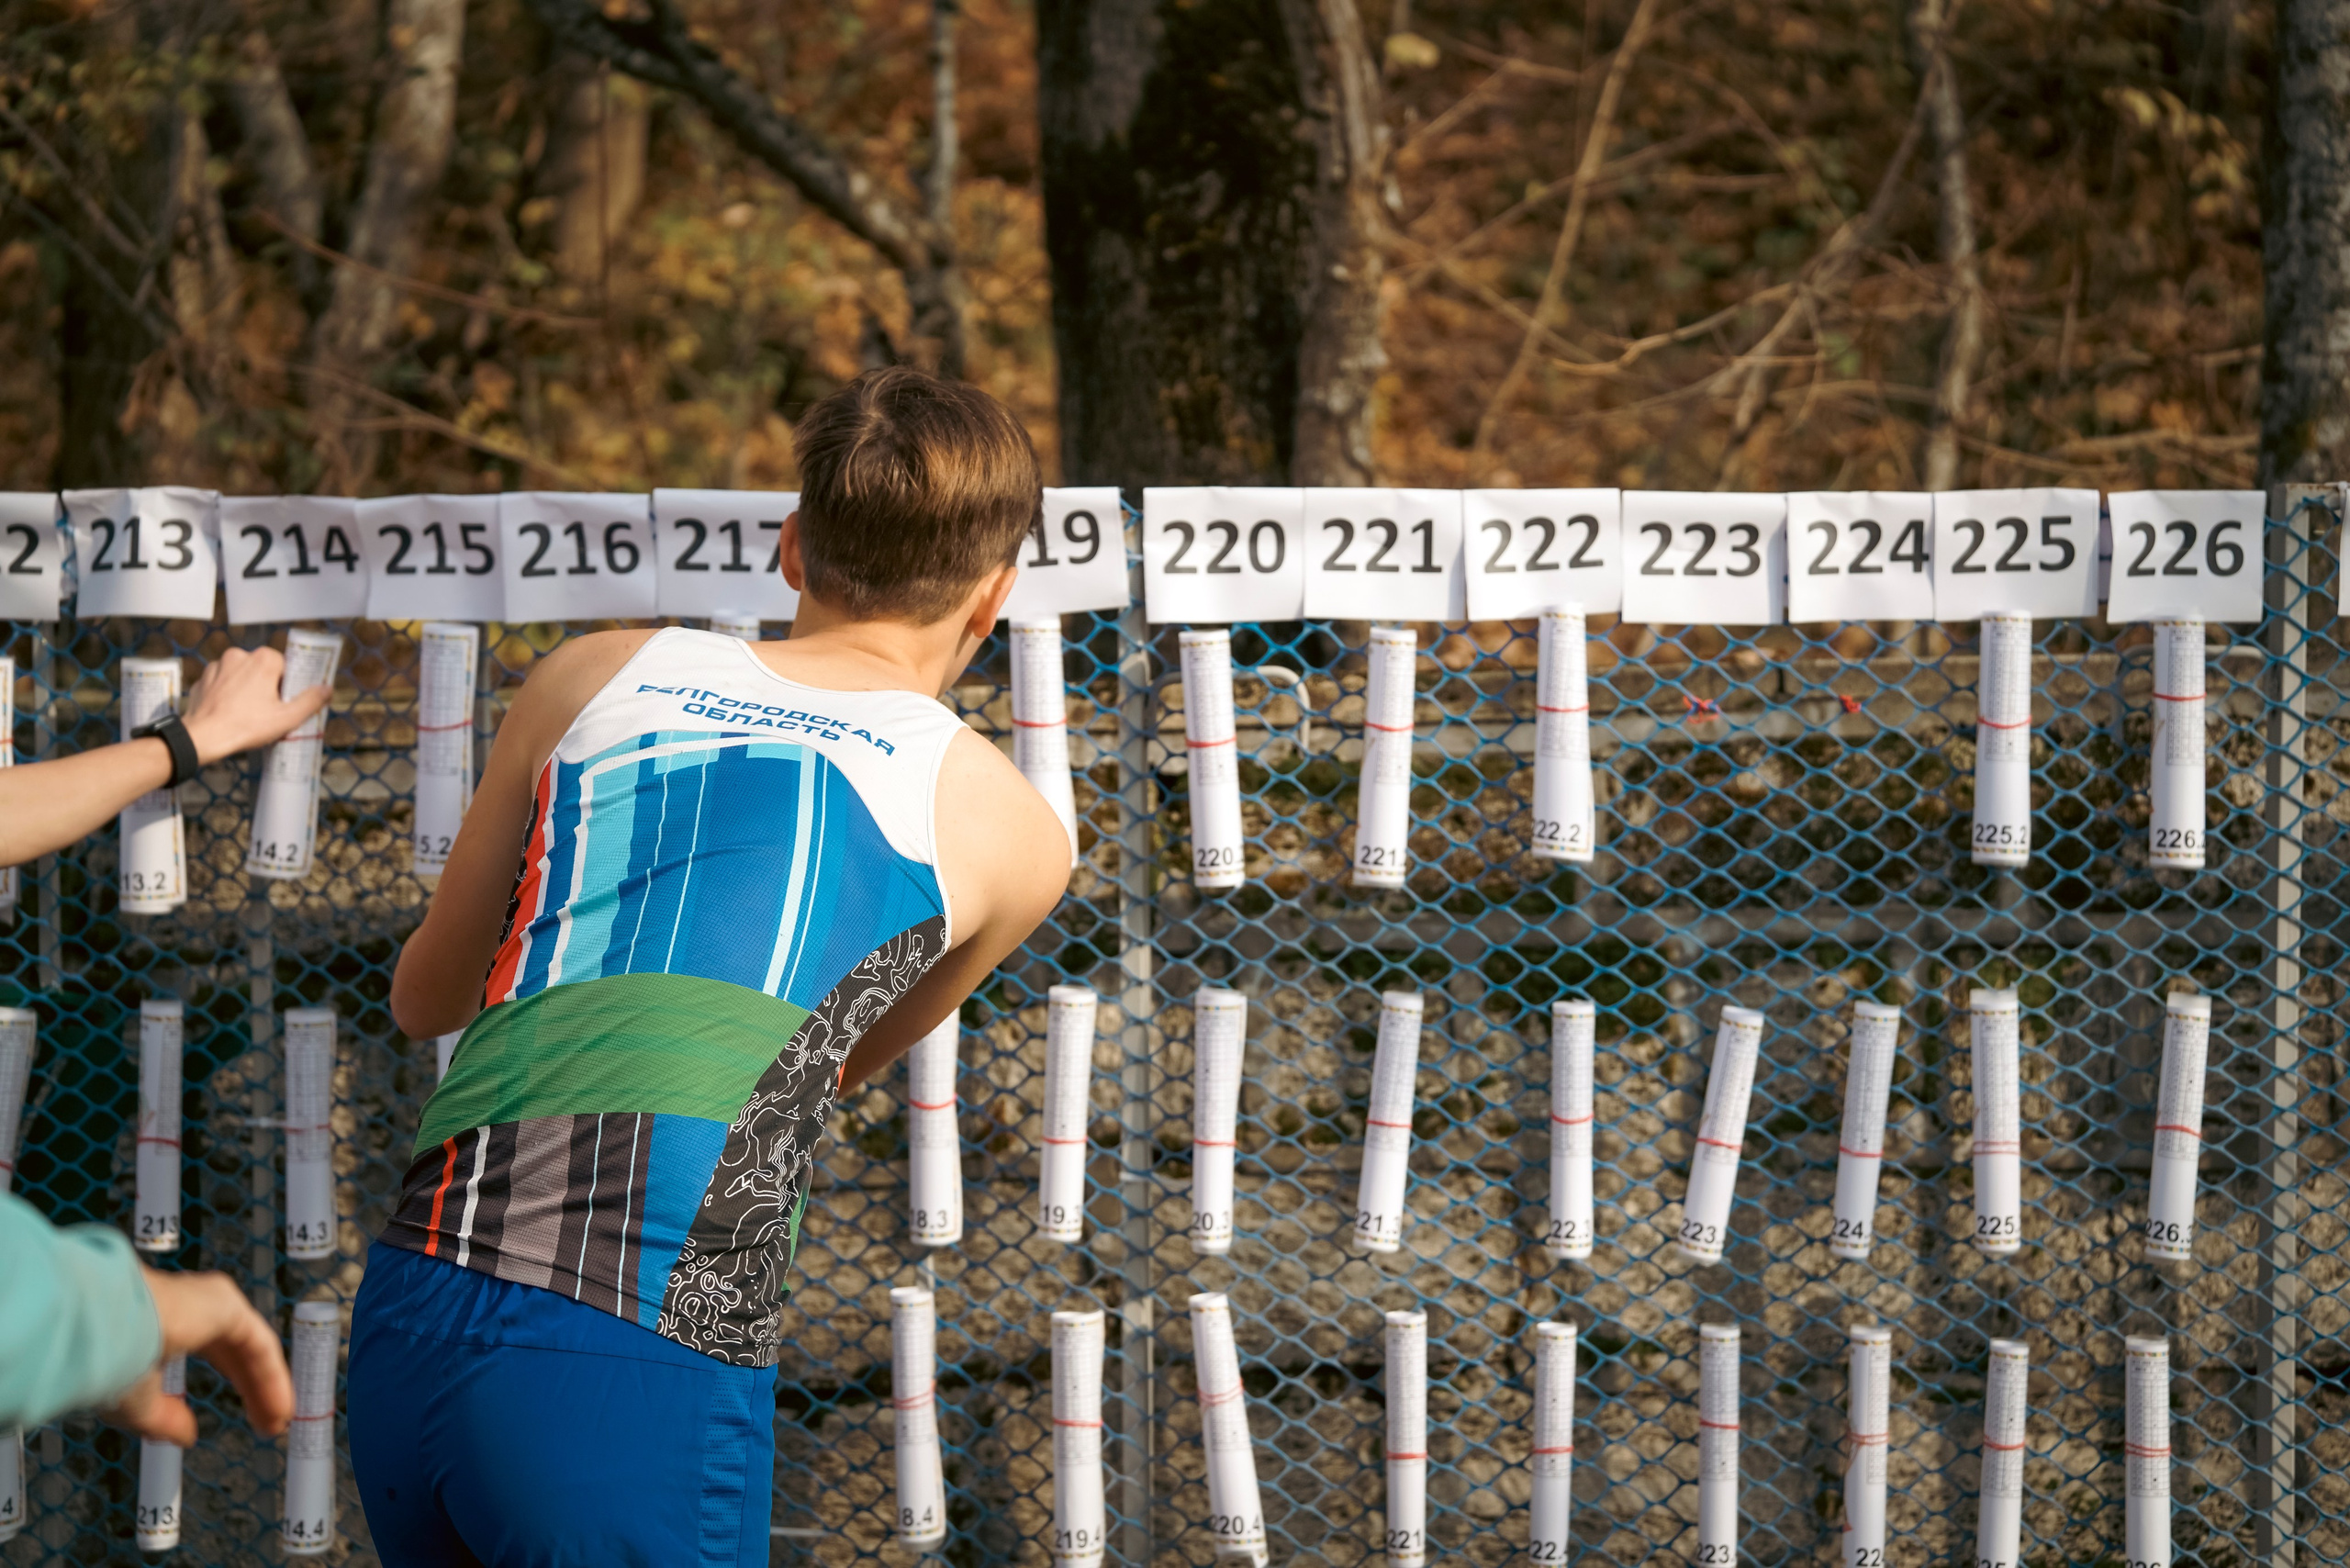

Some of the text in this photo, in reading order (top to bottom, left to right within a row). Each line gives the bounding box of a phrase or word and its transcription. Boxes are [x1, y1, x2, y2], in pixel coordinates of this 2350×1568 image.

[0, 522, 42, 574] 2
[91, 516, 195, 571] 213
[240, 522, 360, 578] 214
[378, 521, 495, 576] 215
[518, 521, 641, 577] 216
[674, 517, 783, 573] 217
[1026, 508, 1101, 568] 19
[1162, 519, 1286, 575] 220
[1322, 518, 1443, 573] 221
[1481, 513, 1605, 575] 222
[1639, 521, 1762, 577] 223
[1807, 519, 1930, 575] 224
[1951, 515, 2076, 574] 225
[2126, 520, 2244, 577] 226
[682, 702, 841, 742] ОБЛАСТЬ
[255, 838, 298, 862] 14.2
[420, 834, 452, 856] 5.2
[1535, 819, 1581, 843] 22.2
[122, 870, 166, 891] 13.2
[287, 1221, 328, 1242] 14.3
[916, 1209, 947, 1229] 8.3
[285, 1518, 324, 1540] 14.4
[902, 1506, 933, 1527] 8.4
[1855, 1547, 1881, 1567] 22
